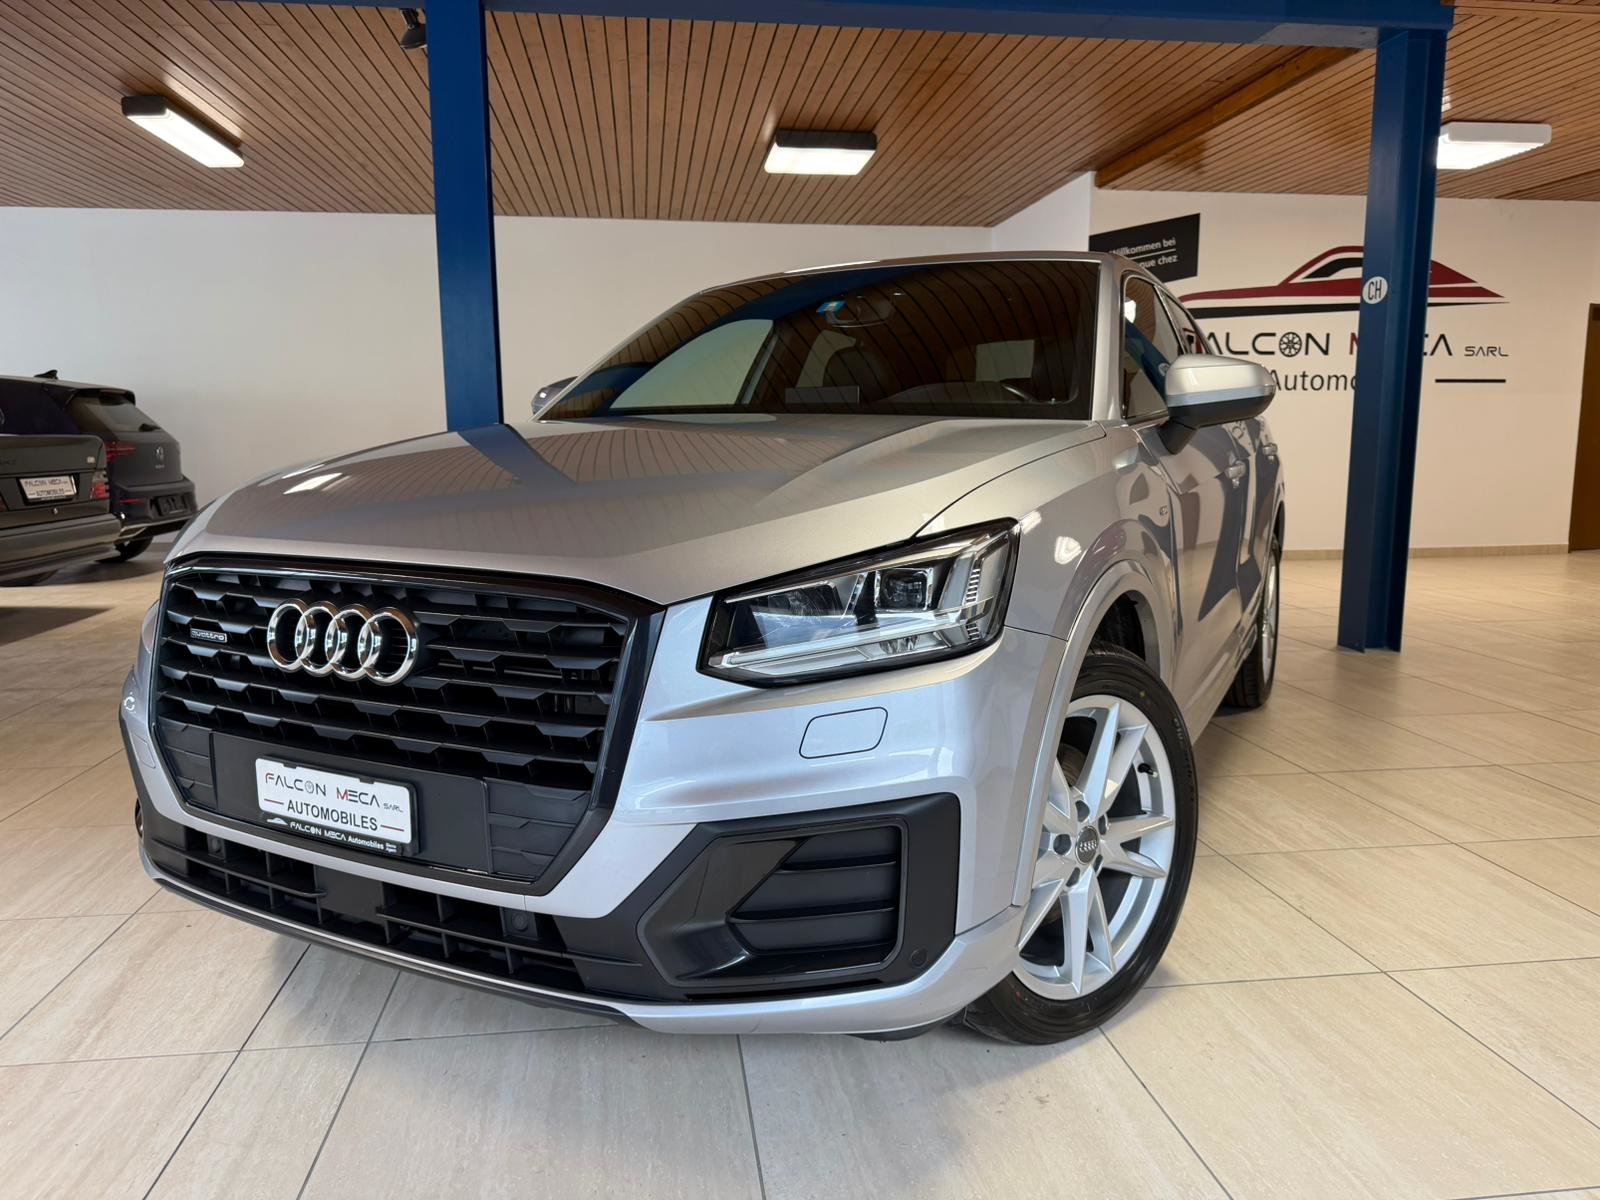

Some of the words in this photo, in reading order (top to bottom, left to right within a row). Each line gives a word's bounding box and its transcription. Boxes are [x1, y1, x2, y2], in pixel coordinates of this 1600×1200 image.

[1162, 237, 1177, 249] bei
[1157, 254, 1178, 265] chez
[1367, 279, 1382, 300] CH
[1464, 346, 1509, 357] SARL
[265, 772, 327, 797] FALCON
[336, 787, 380, 808] MECA
[287, 799, 378, 831] AUTOMOBILES
[290, 821, 322, 835] FALCON
[324, 829, 347, 842] MECA
[347, 835, 384, 850] Automobiles
